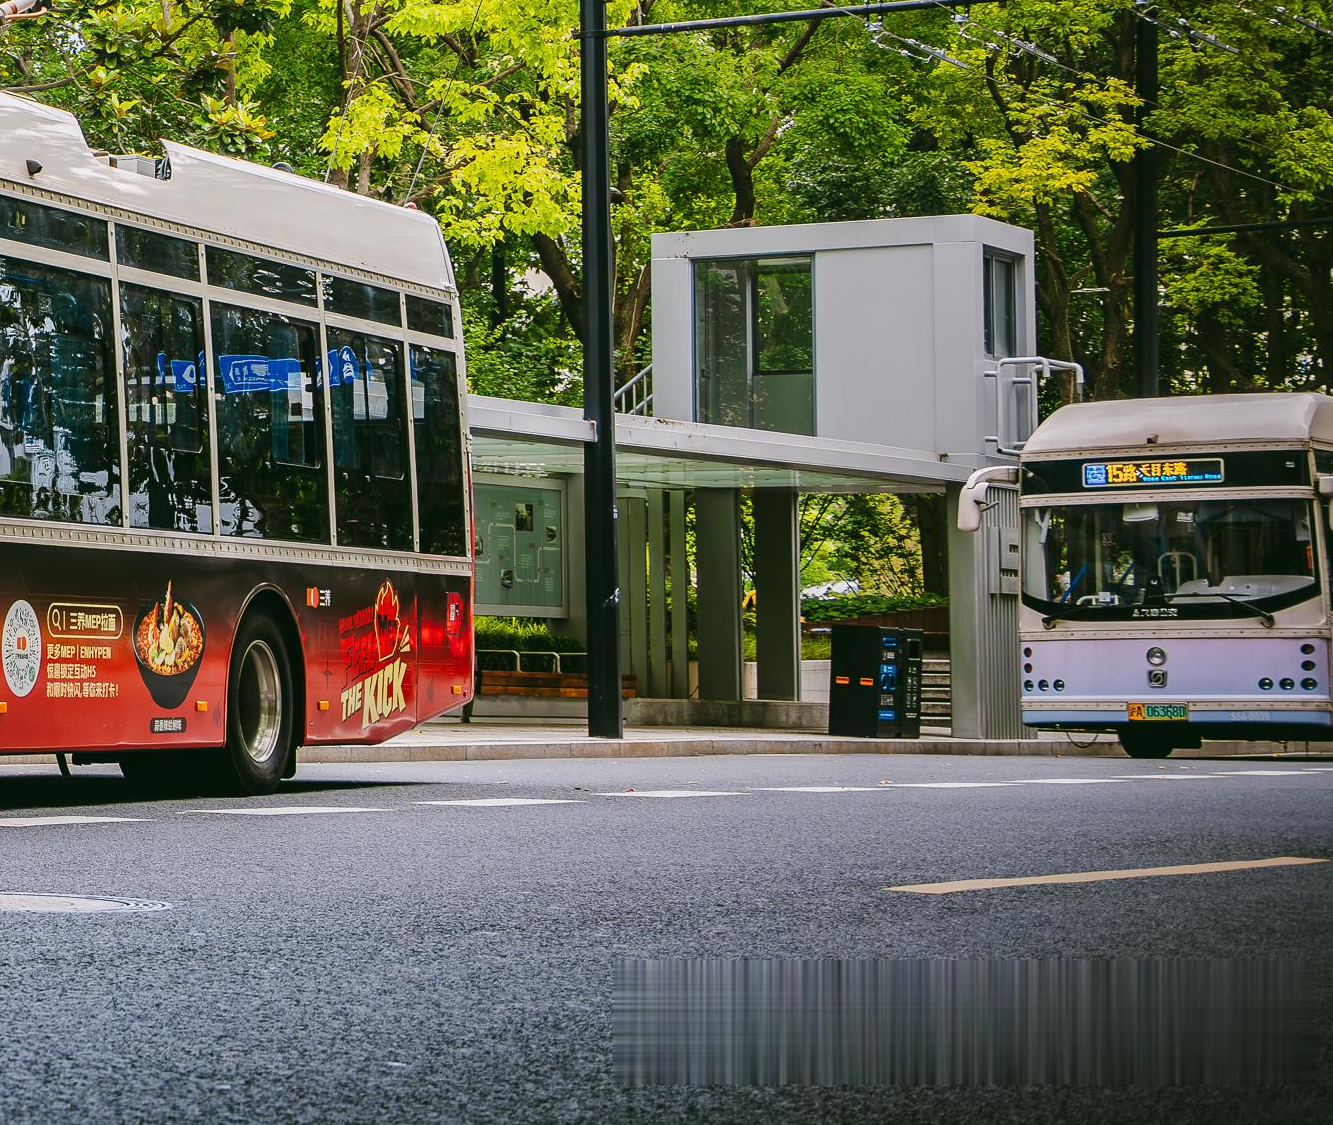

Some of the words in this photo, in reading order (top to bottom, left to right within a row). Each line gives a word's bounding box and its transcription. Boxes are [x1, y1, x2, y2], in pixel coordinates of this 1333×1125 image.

[1106, 464, 1137, 483] 15路
[1141, 462, 1187, 477] 天目东路
[319, 589, 331, 607] 三养
[69, 612, 116, 632] 三养MEP拉面
[340, 681, 363, 722] THE
[362, 657, 408, 730] KICK
